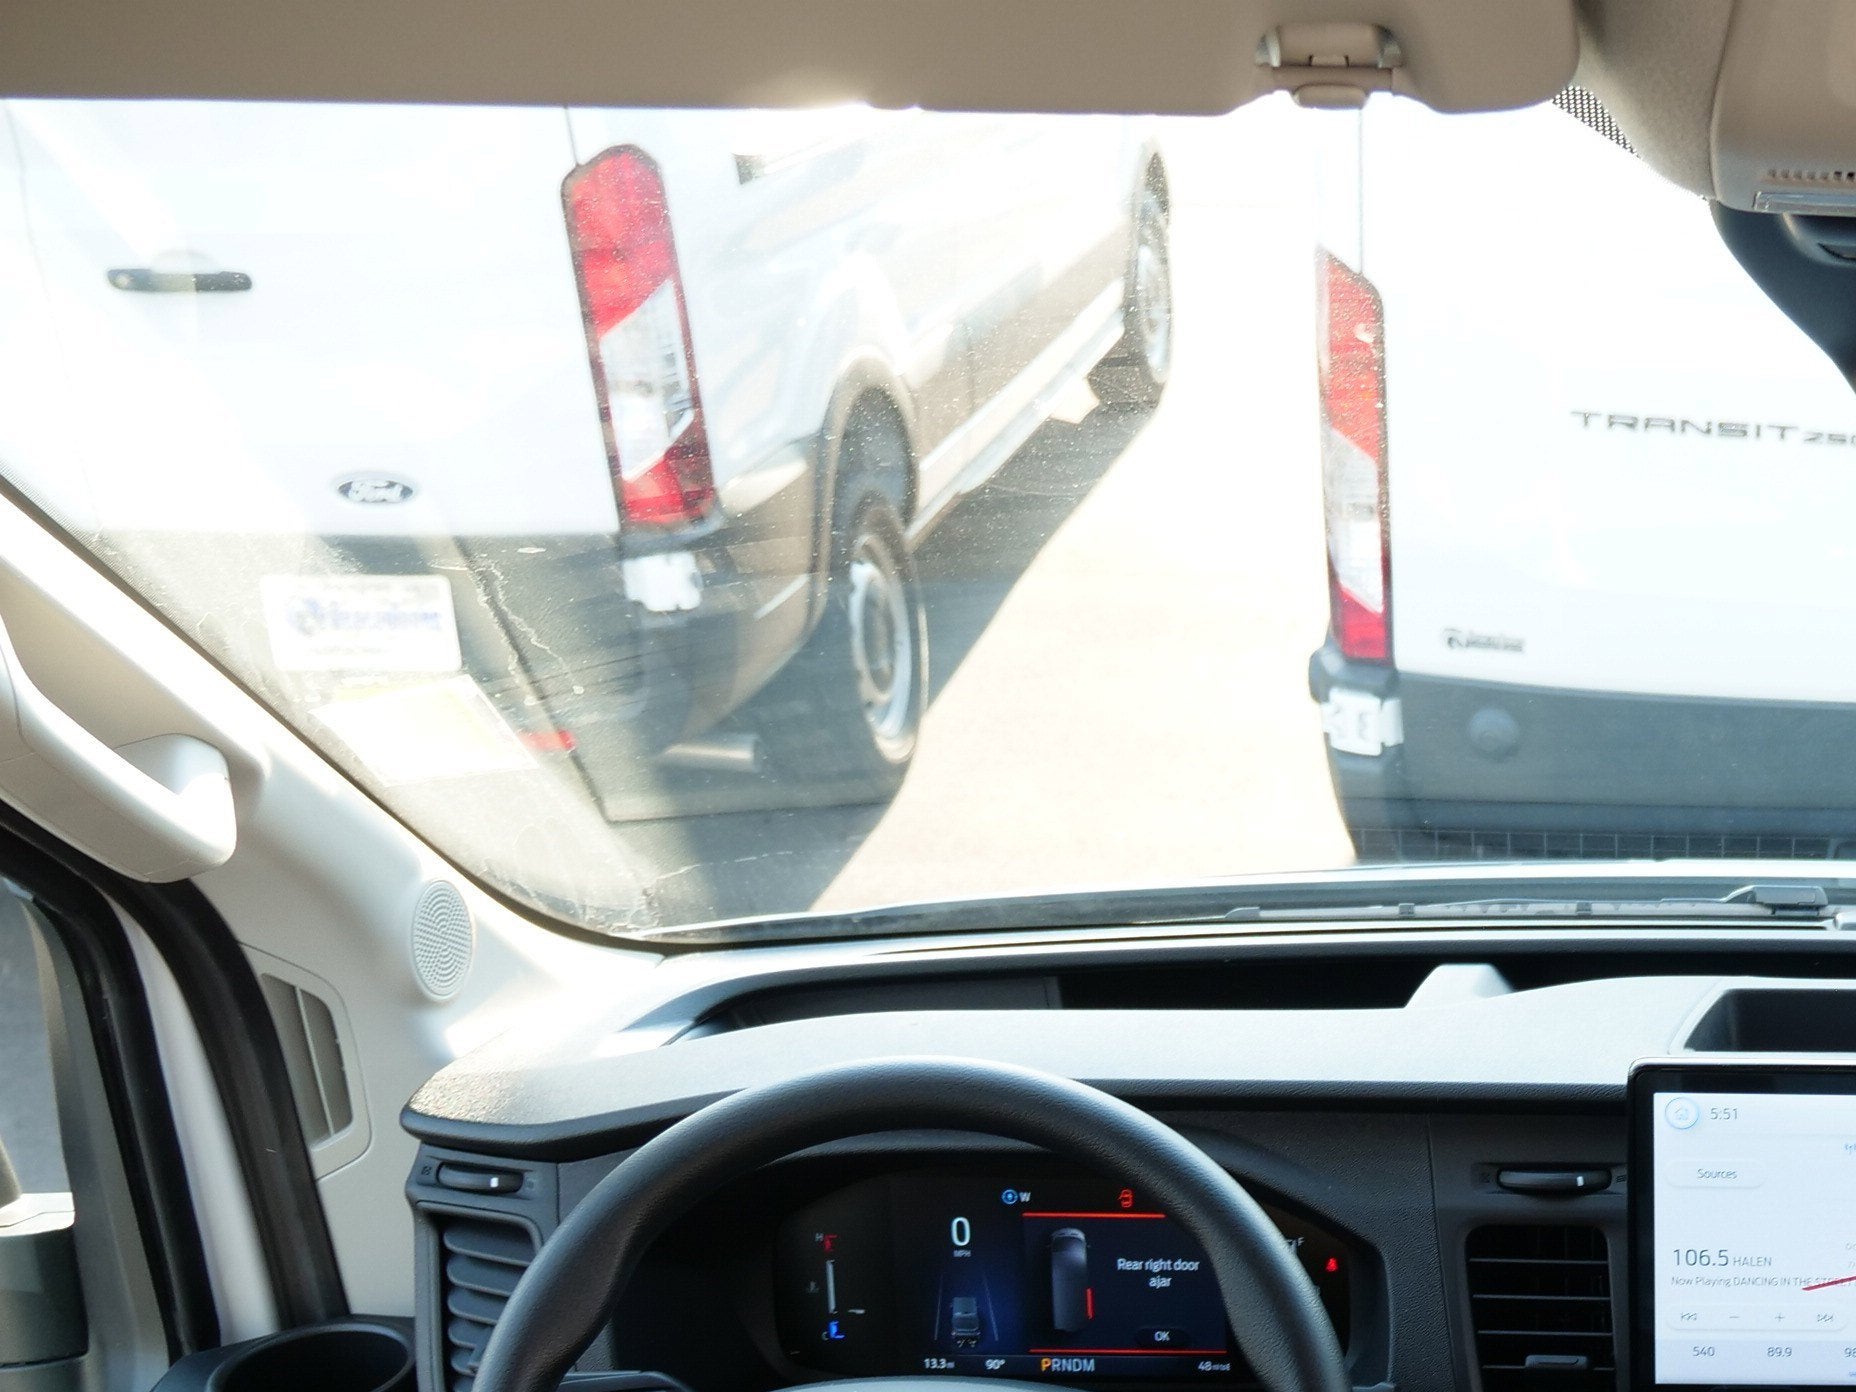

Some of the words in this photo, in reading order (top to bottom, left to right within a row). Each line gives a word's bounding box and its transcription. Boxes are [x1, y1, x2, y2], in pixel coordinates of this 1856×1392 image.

[1571, 410, 1800, 441] TRANSIT
[1710, 1107, 1739, 1120] 5:51
[1697, 1168, 1738, 1180] Sources
[950, 1215, 972, 1248] 0
[1673, 1249, 1730, 1267] 106.5
[1733, 1256, 1772, 1267] HALEN
[1117, 1257, 1143, 1272] Rear
[1145, 1257, 1171, 1275] right
[1173, 1257, 1200, 1272] door
[1148, 1274, 1173, 1290] ajar
[1733, 1277, 1778, 1287] DANCING
[1154, 1330, 1171, 1342] OK
[1692, 1346, 1715, 1357] 540
[1767, 1346, 1792, 1358] 89.9
